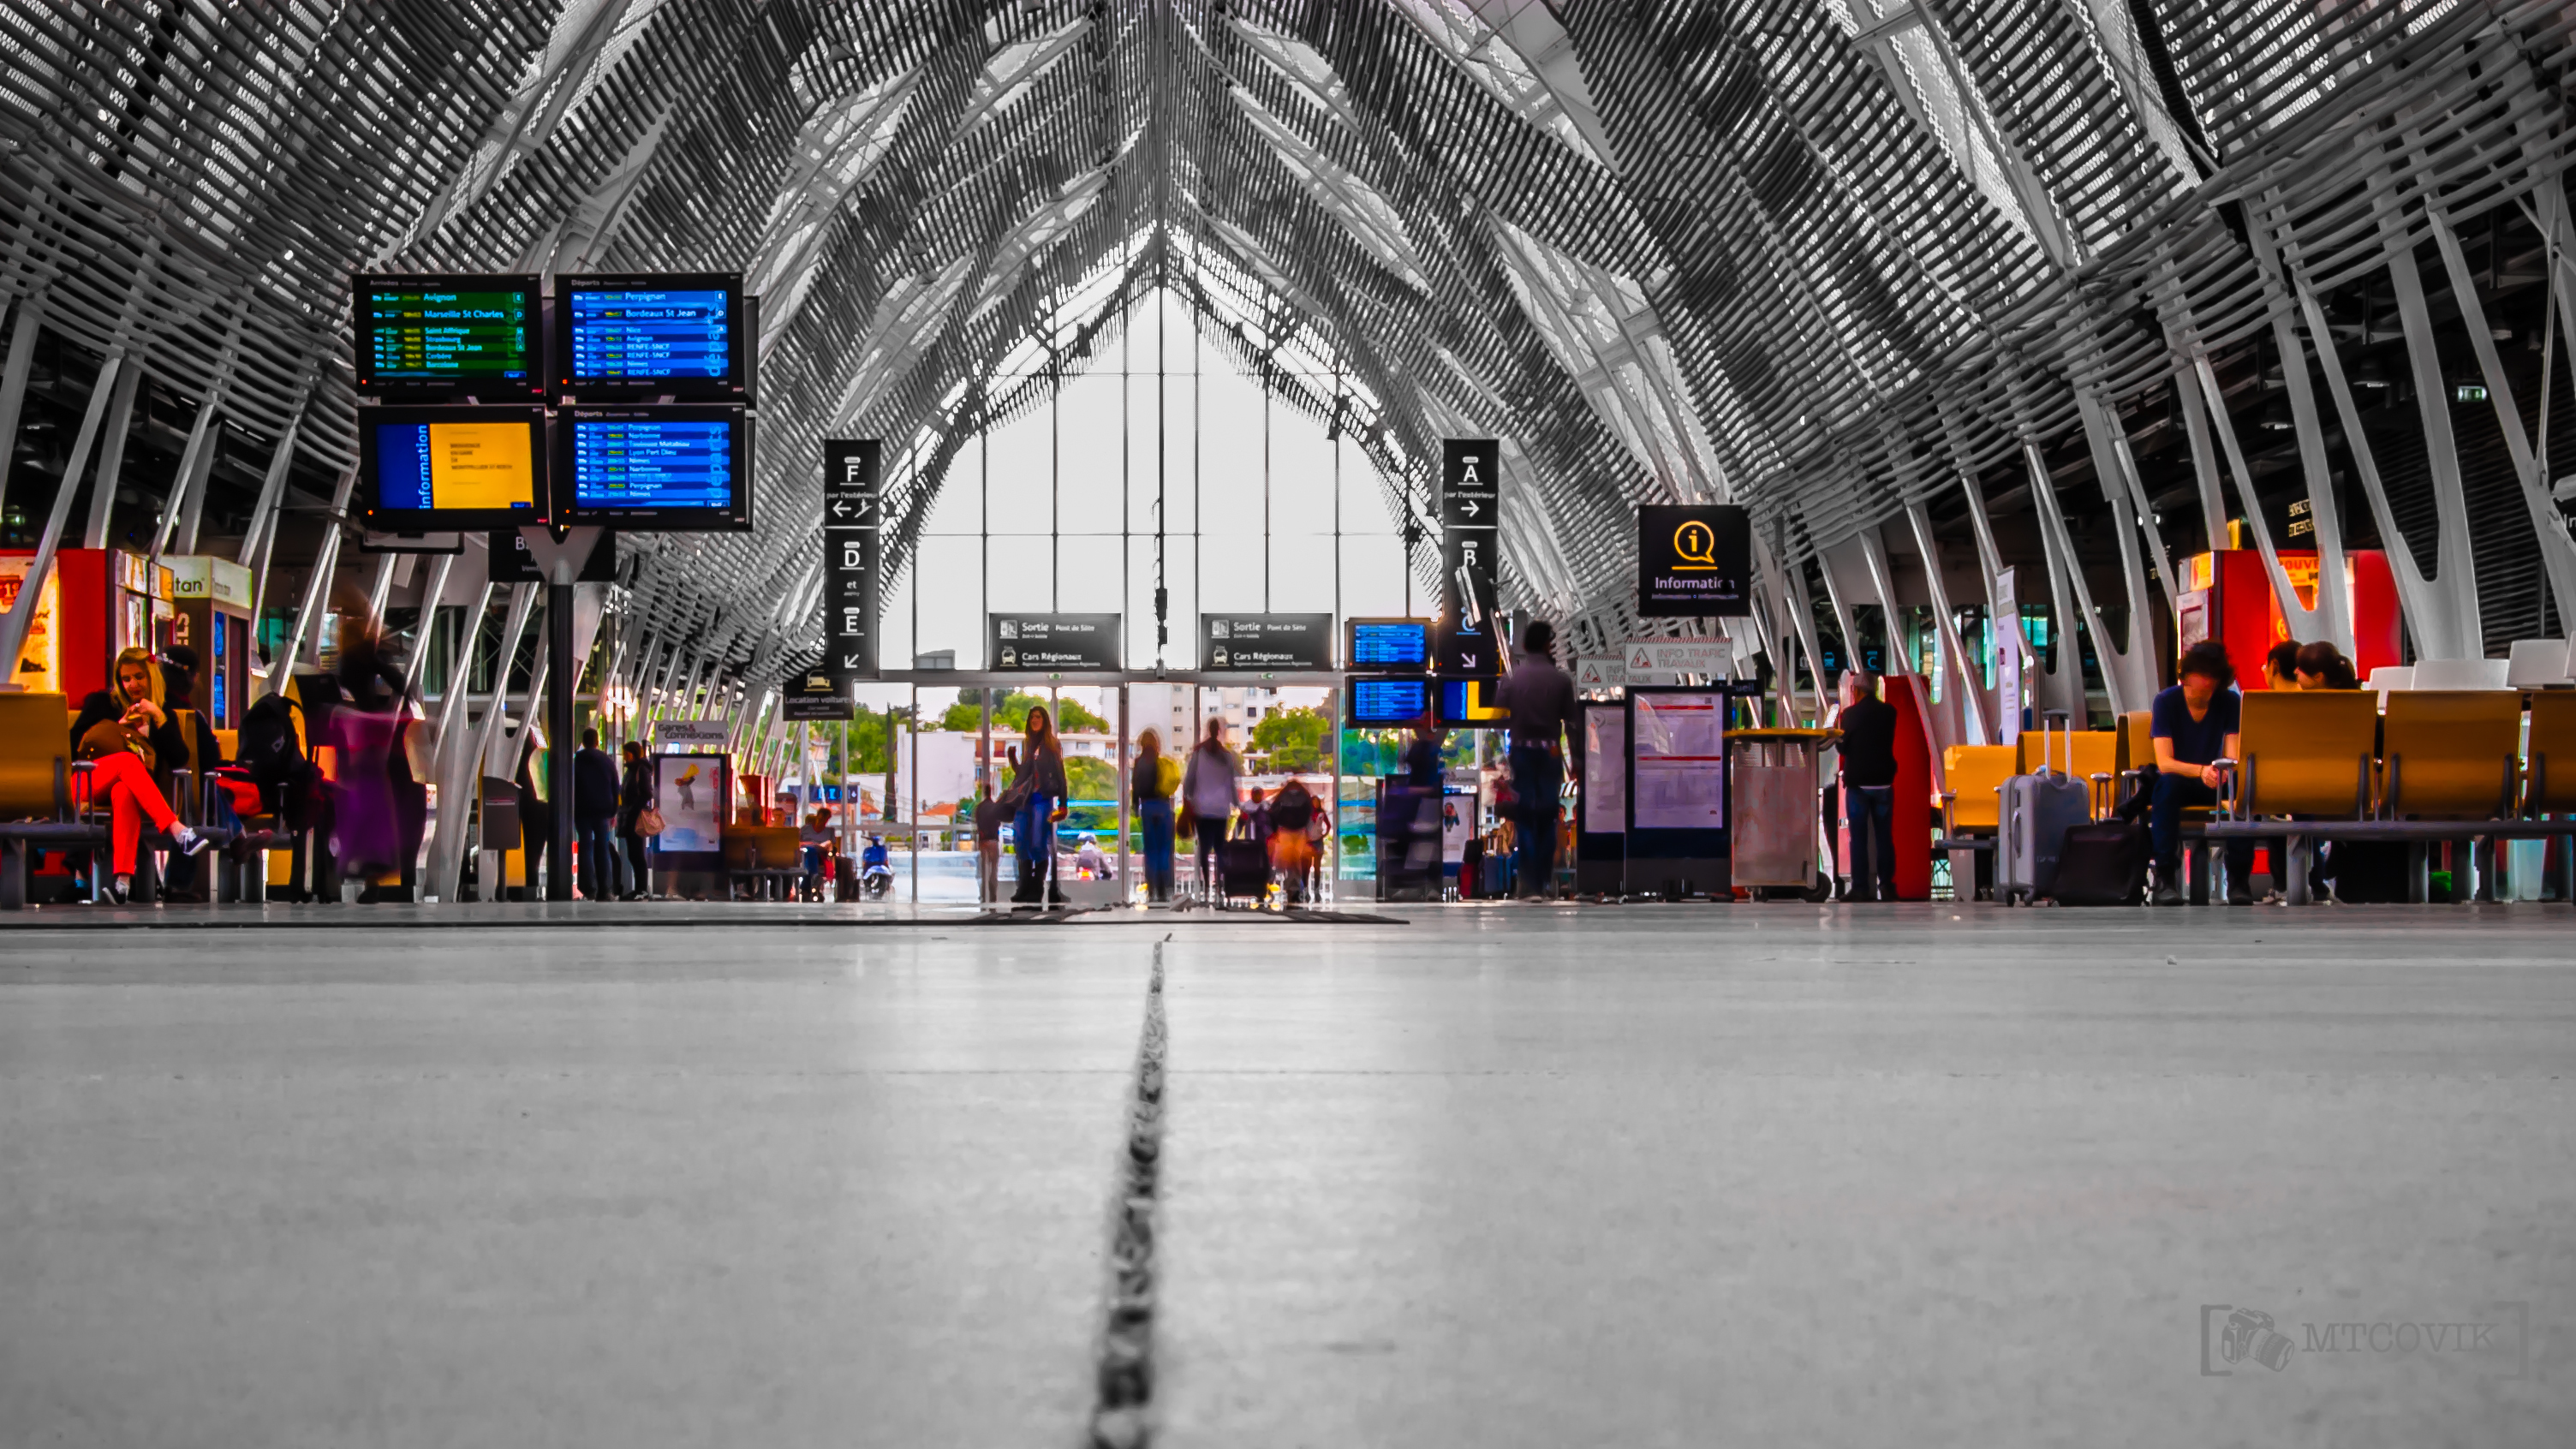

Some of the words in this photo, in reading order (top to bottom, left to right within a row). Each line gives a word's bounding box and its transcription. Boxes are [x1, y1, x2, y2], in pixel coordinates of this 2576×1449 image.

[625, 292, 666, 302] Perpignan
[424, 310, 461, 319] Marseille
[462, 310, 472, 319] St
[473, 309, 504, 319] Charles
[625, 309, 664, 318] Bordeaux
[665, 309, 675, 318] St
[677, 309, 696, 318] Jean
[706, 426, 726, 498] départs
[415, 425, 432, 510] information
[847, 465, 859, 482] F
[1463, 464, 1479, 482] A
[844, 550, 860, 567] D
[1464, 549, 1476, 566] B
[846, 581, 857, 589] et
[846, 616, 857, 633] E
[1022, 622, 1049, 632] Sortie
[1055, 623, 1070, 632] Pont
[1071, 623, 1080, 632] de
[1233, 622, 1261, 632] Sortie
[1267, 623, 1282, 632] Pont
[1283, 623, 1291, 632] de
[1022, 653, 1040, 661] Cars
[1041, 652, 1082, 662] Régionaux
[1233, 652, 1251, 661] Cars
[1253, 652, 1294, 662] Régionaux
[1657, 648, 1684, 657] INFO
[1688, 648, 1726, 658] TRAFIC
[1658, 659, 1706, 668] TRAVAUX
[784, 695, 820, 704] Location
[658, 724, 689, 733] Gares
[664, 731, 724, 740] Connexions
